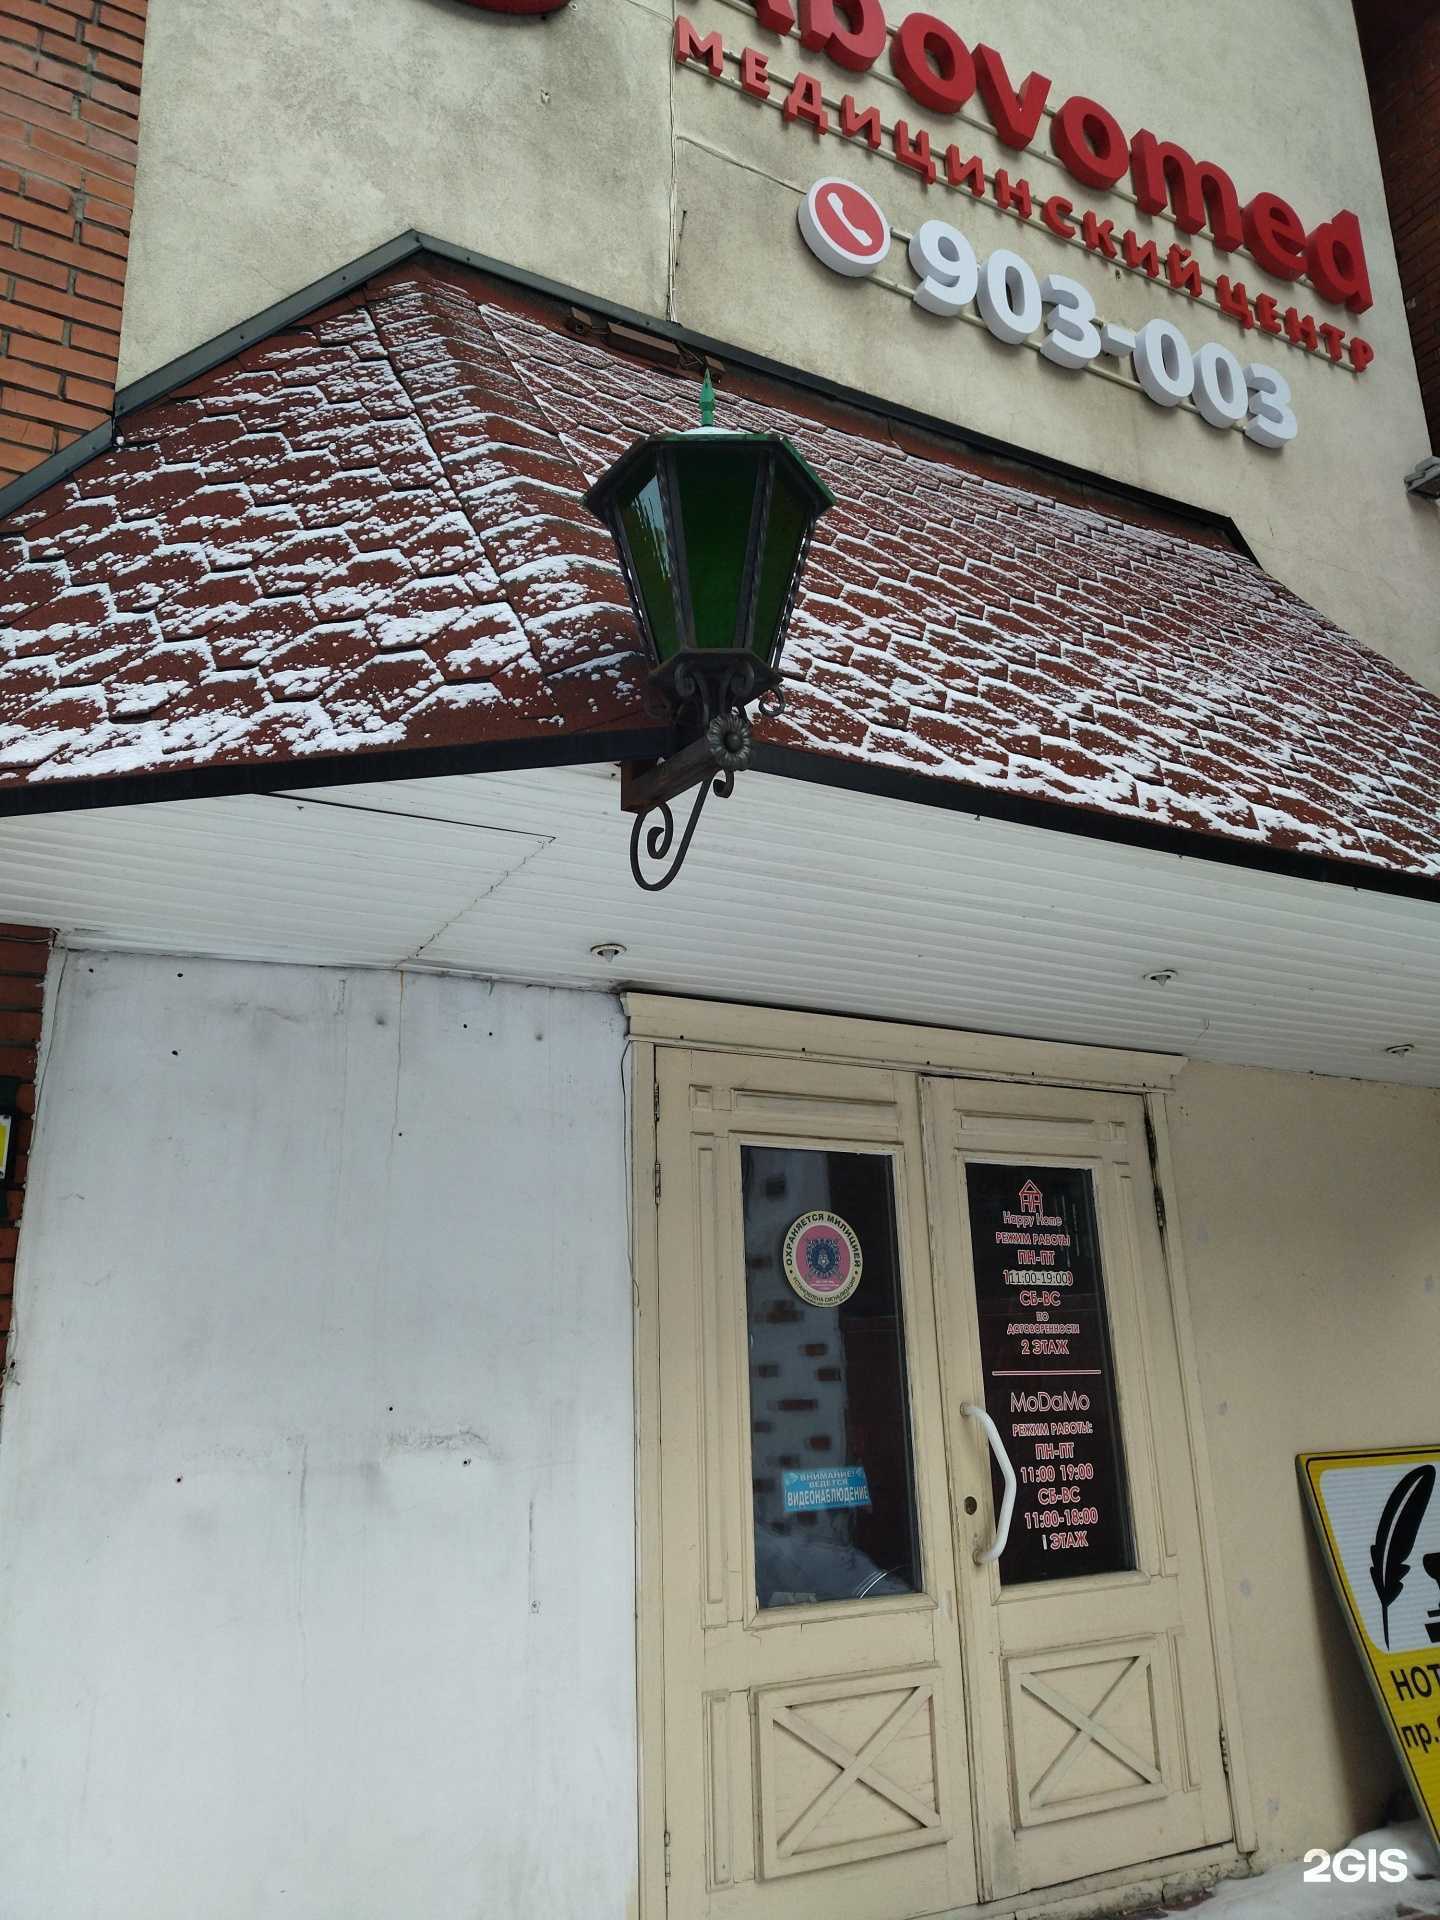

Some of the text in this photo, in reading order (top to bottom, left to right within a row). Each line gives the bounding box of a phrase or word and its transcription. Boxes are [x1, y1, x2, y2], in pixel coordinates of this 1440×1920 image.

[674, 15, 1375, 373] МЕДИЦИНСКИЙ ЦЕНТР
[909, 219, 1298, 449] 903-003
[1002, 1210, 1063, 1228] Happy Home
[785, 1213, 862, 1268] ОХРАНЯЕТСЯ МИЛИЦИЕЙ
[995, 1231, 1032, 1245] РЕЖИМ
[1017, 1249, 1056, 1266] ПН-ПТ
[1019, 1290, 1061, 1306] СБ-ВС
[1006, 1323, 1080, 1335] ДОГОВОРЕННОСТИ
[1020, 1339, 1070, 1355] 2 ЭТАЖ
[1010, 1390, 1090, 1413] MoDaMo
[1012, 1421, 1093, 1437] РЕЖИМ РАБОТЫ:
[1035, 1442, 1075, 1460] ПН-ПТ
[1020, 1462, 1094, 1484] 11:00 19:00
[787, 1486, 869, 1507] ВИДЕОНАБЛЮДЕНИЕ
[1037, 1486, 1081, 1505] СБ-ВС
[1024, 1507, 1099, 1529] 11:00-18:00
[1050, 1531, 1089, 1550] ЭТАЖ
